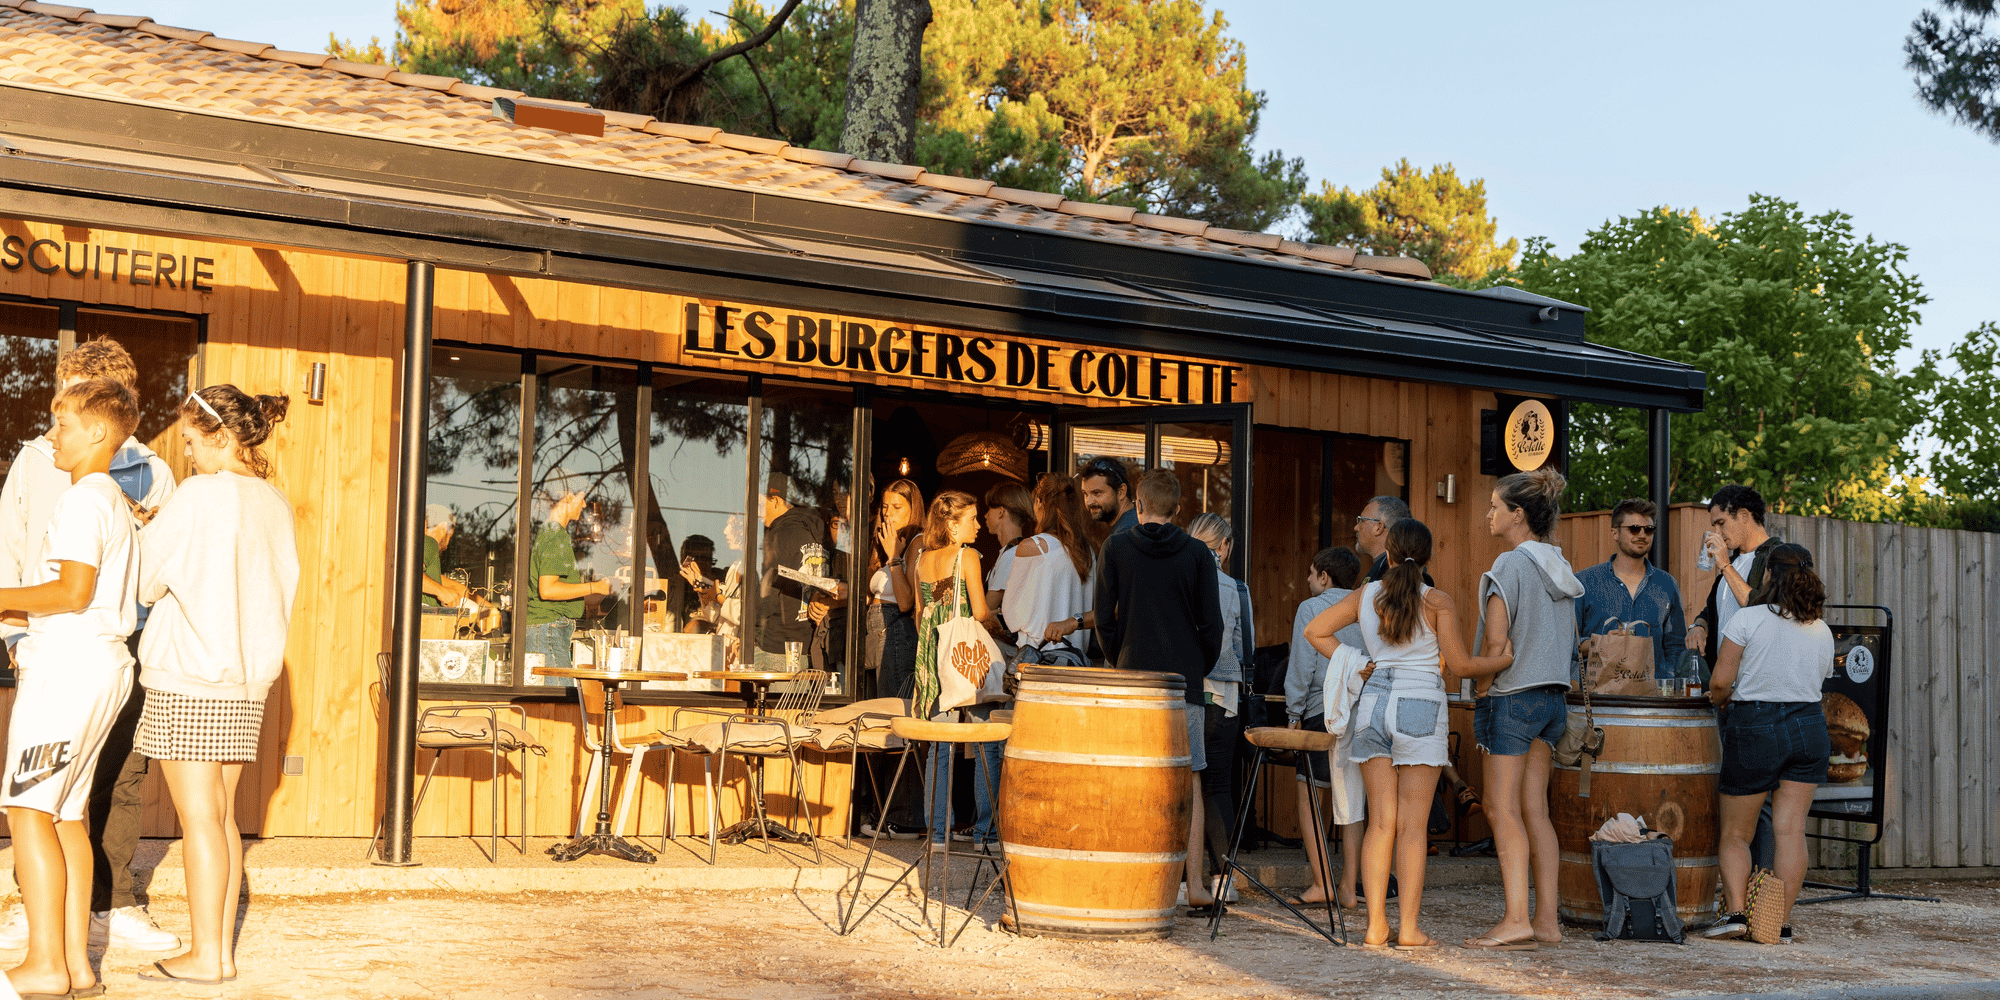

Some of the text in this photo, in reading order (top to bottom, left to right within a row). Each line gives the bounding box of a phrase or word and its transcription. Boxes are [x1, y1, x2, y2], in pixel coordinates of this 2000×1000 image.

[1, 235, 214, 291] SCUITERIE
[684, 302, 1243, 404] LES BURGERS DE COLETTE
[1517, 440, 1546, 453] Colette
[17, 740, 71, 775] NIKE
